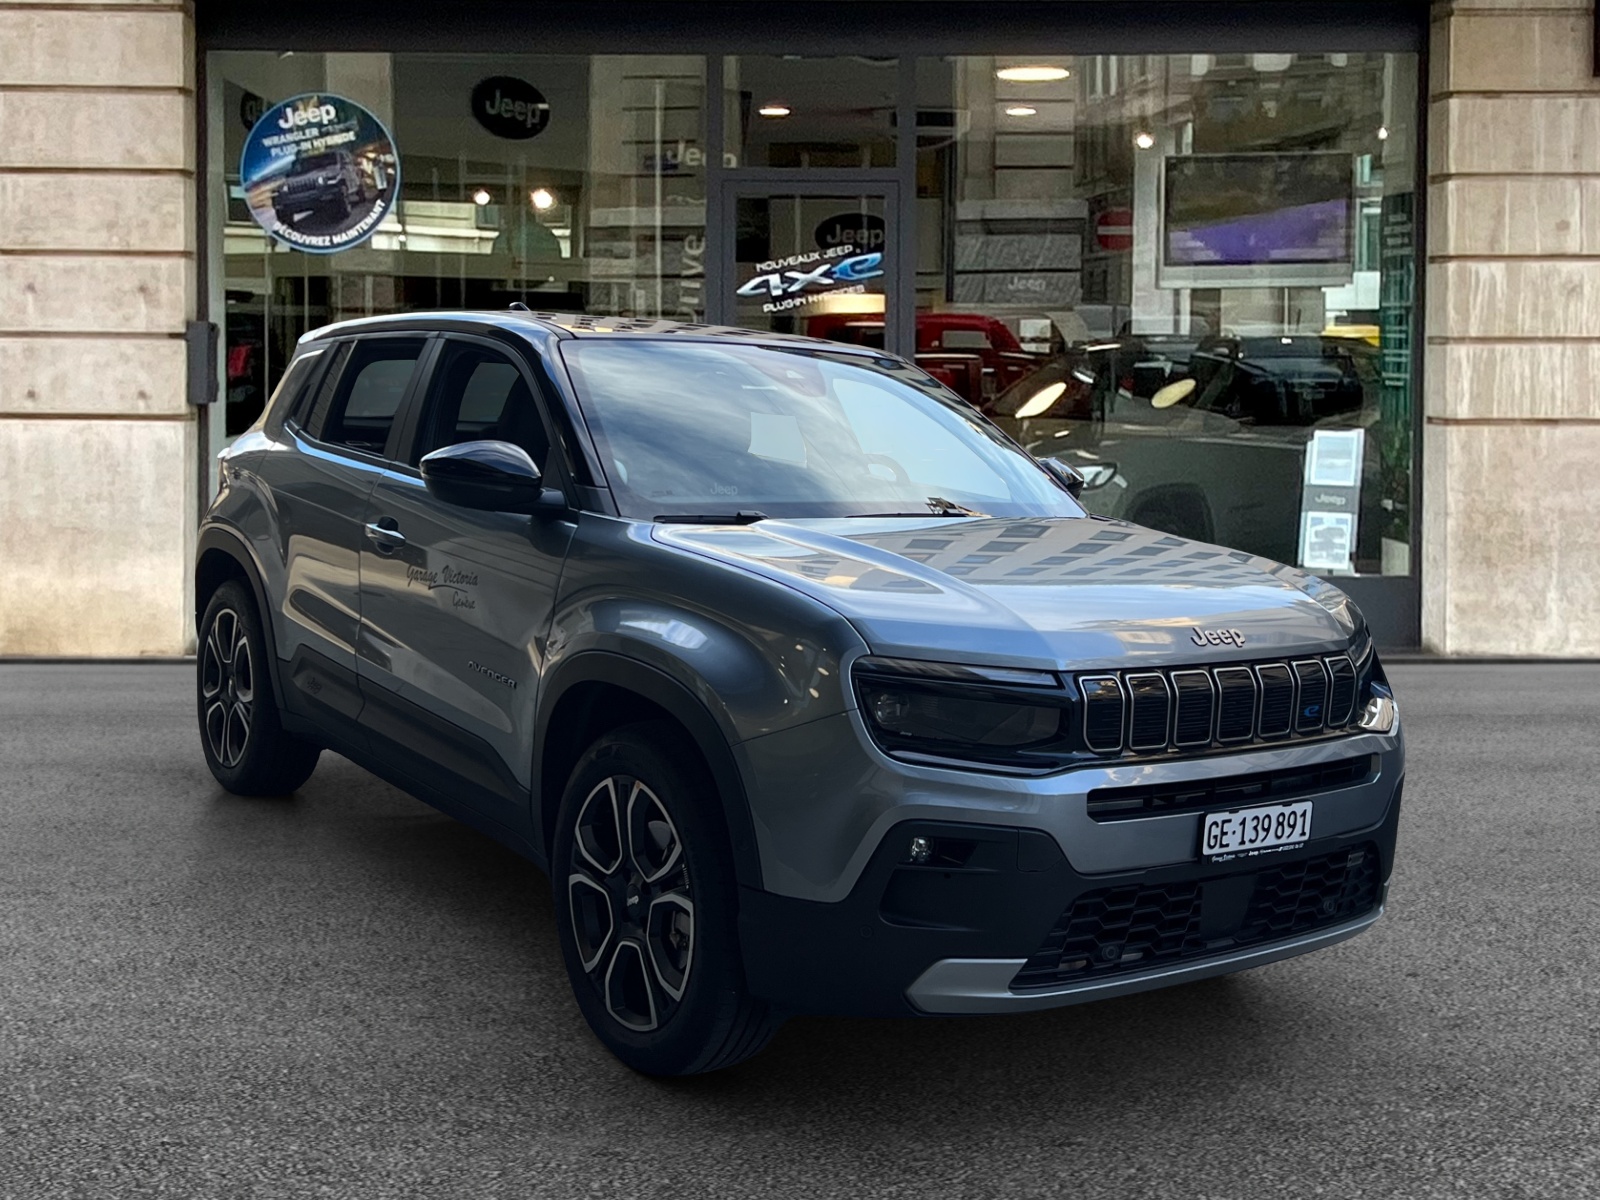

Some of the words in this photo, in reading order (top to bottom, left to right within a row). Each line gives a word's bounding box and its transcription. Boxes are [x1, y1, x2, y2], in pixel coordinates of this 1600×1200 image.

[278, 104, 337, 129] Jeep
[485, 88, 541, 128] Jeep
[262, 127, 319, 147] WRANGLER
[272, 220, 331, 246] DÉCOUVREZ
[332, 199, 386, 244] MAINTENANT
[826, 223, 884, 249] Jeep
[756, 251, 821, 272] NOUVEAUX
[823, 244, 854, 259] JEEP
[710, 482, 738, 496] Jeep
[1314, 493, 1346, 506] Jeep
[406, 564, 438, 588] Garage
[441, 564, 479, 587] Victoria
[1190, 626, 1246, 648] Jeep
[467, 660, 517, 689] AVENGER
